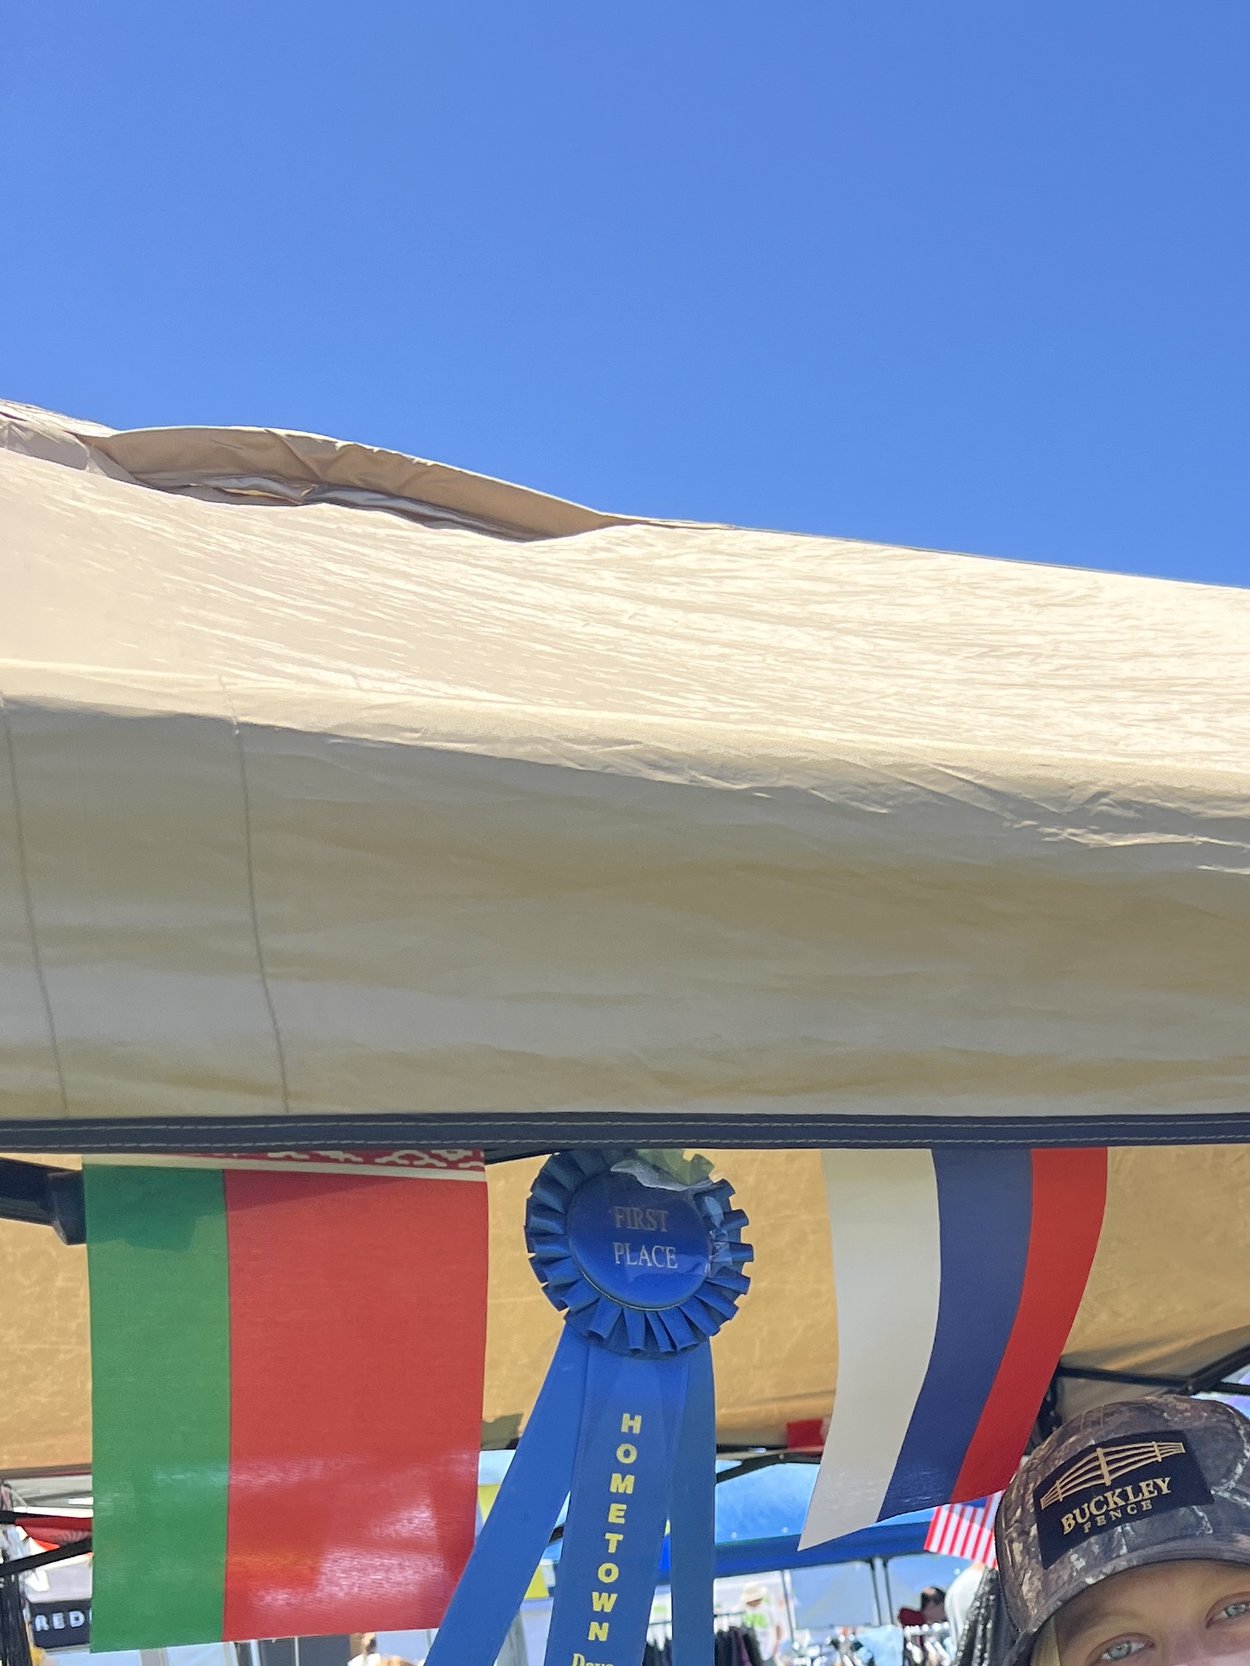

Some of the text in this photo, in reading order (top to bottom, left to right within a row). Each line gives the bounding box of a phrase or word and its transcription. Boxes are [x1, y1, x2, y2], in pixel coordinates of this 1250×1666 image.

[612, 1205, 669, 1233] FIRST
[612, 1241, 678, 1269] PLACE
[1060, 1476, 1171, 1535] BUCKLEY
[1082, 1499, 1153, 1534] FENCE
[34, 1610, 92, 1632] RED
